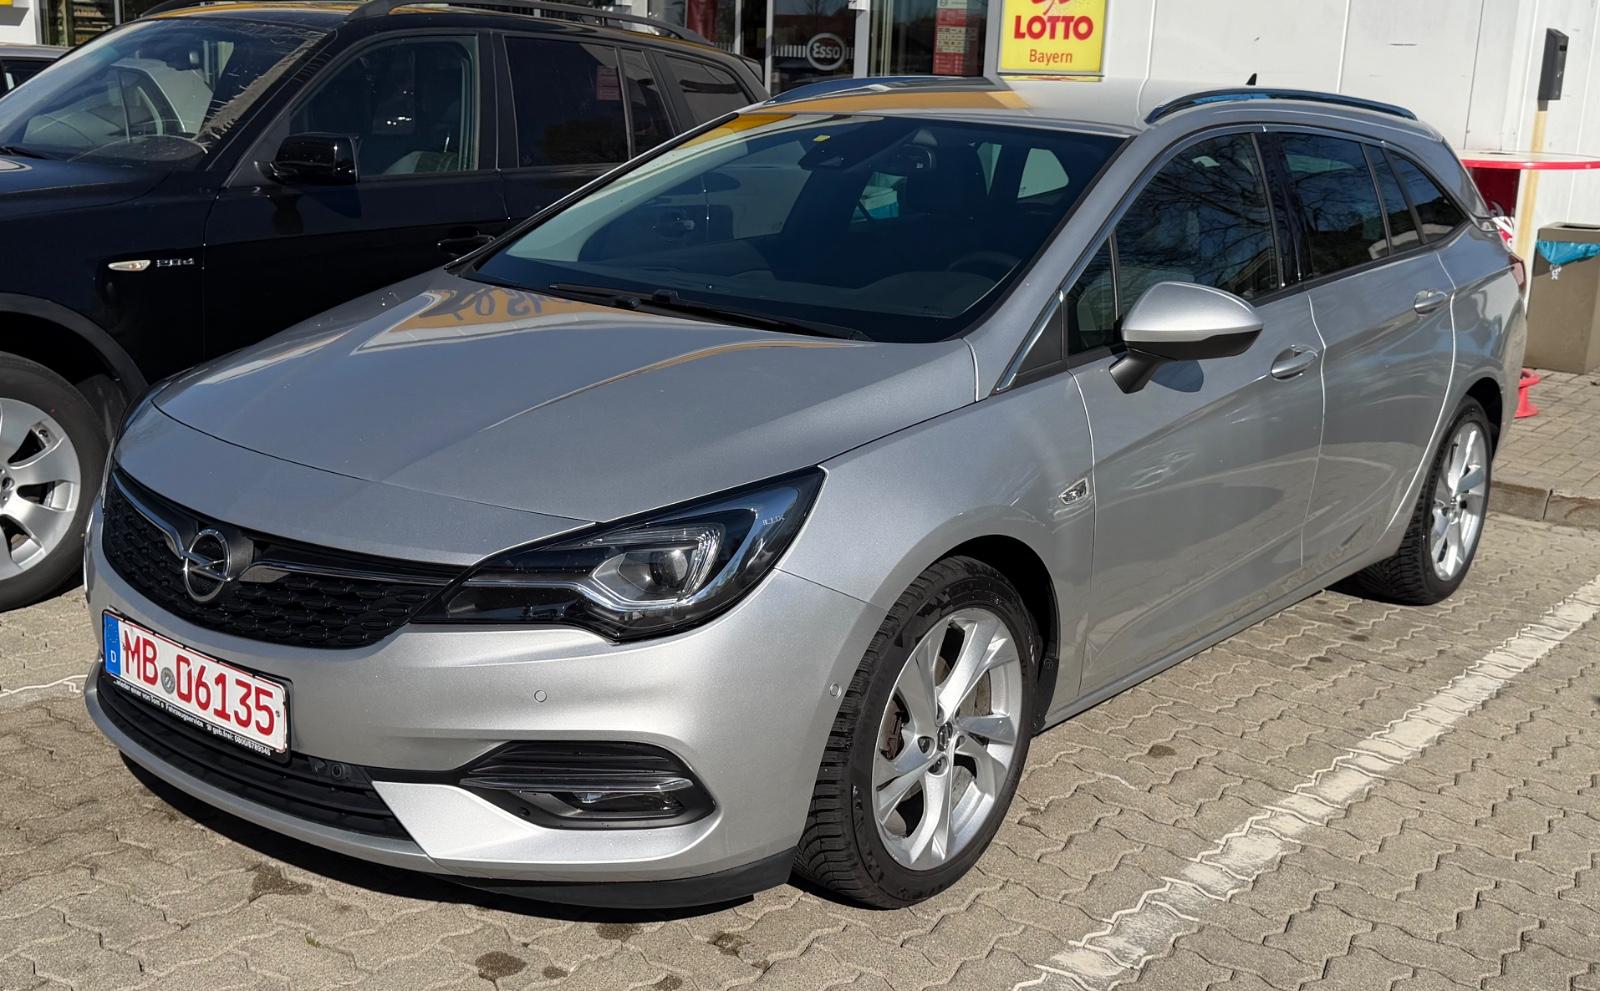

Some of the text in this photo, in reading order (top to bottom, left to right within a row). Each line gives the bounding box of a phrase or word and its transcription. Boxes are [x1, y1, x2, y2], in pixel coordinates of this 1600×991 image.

[1014, 15, 1094, 40] LOTTO
[812, 42, 840, 59] Esso
[1029, 48, 1073, 66] Bayern
[110, 650, 117, 664] D
[124, 630, 275, 736] MB 06135
